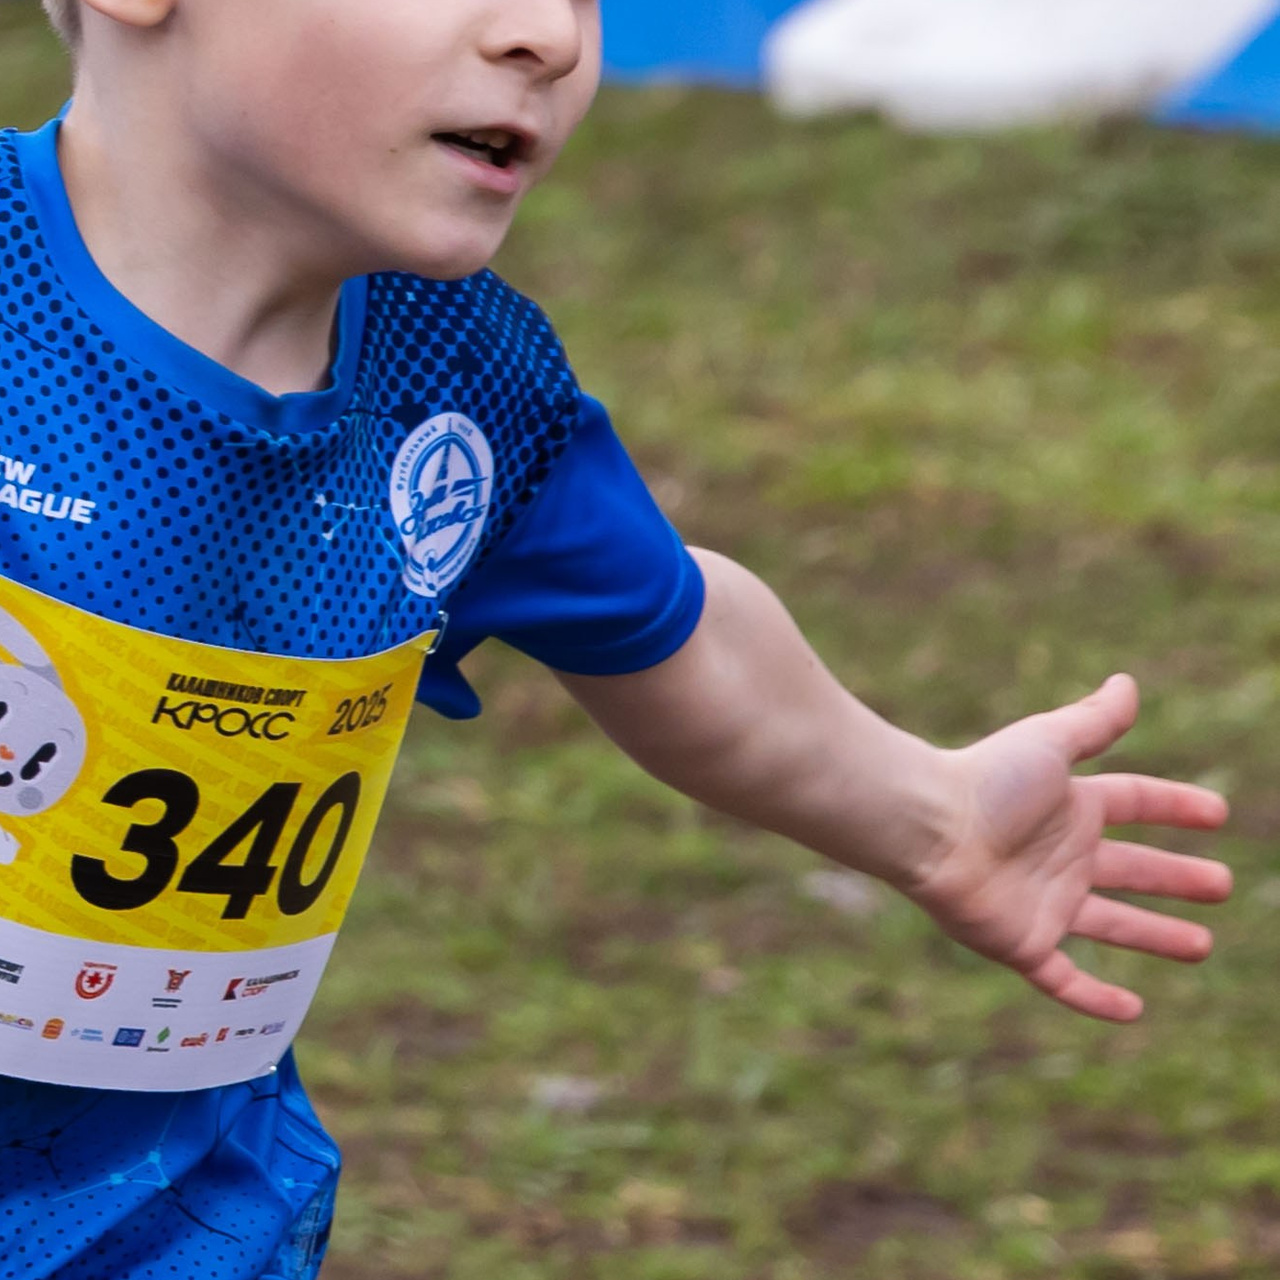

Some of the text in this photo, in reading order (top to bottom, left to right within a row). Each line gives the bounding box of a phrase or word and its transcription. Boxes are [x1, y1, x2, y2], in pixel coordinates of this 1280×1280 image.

[151, 695, 296, 741] КРОСС
[327, 682, 393, 736] 2025
[70, 767, 362, 920] 340
